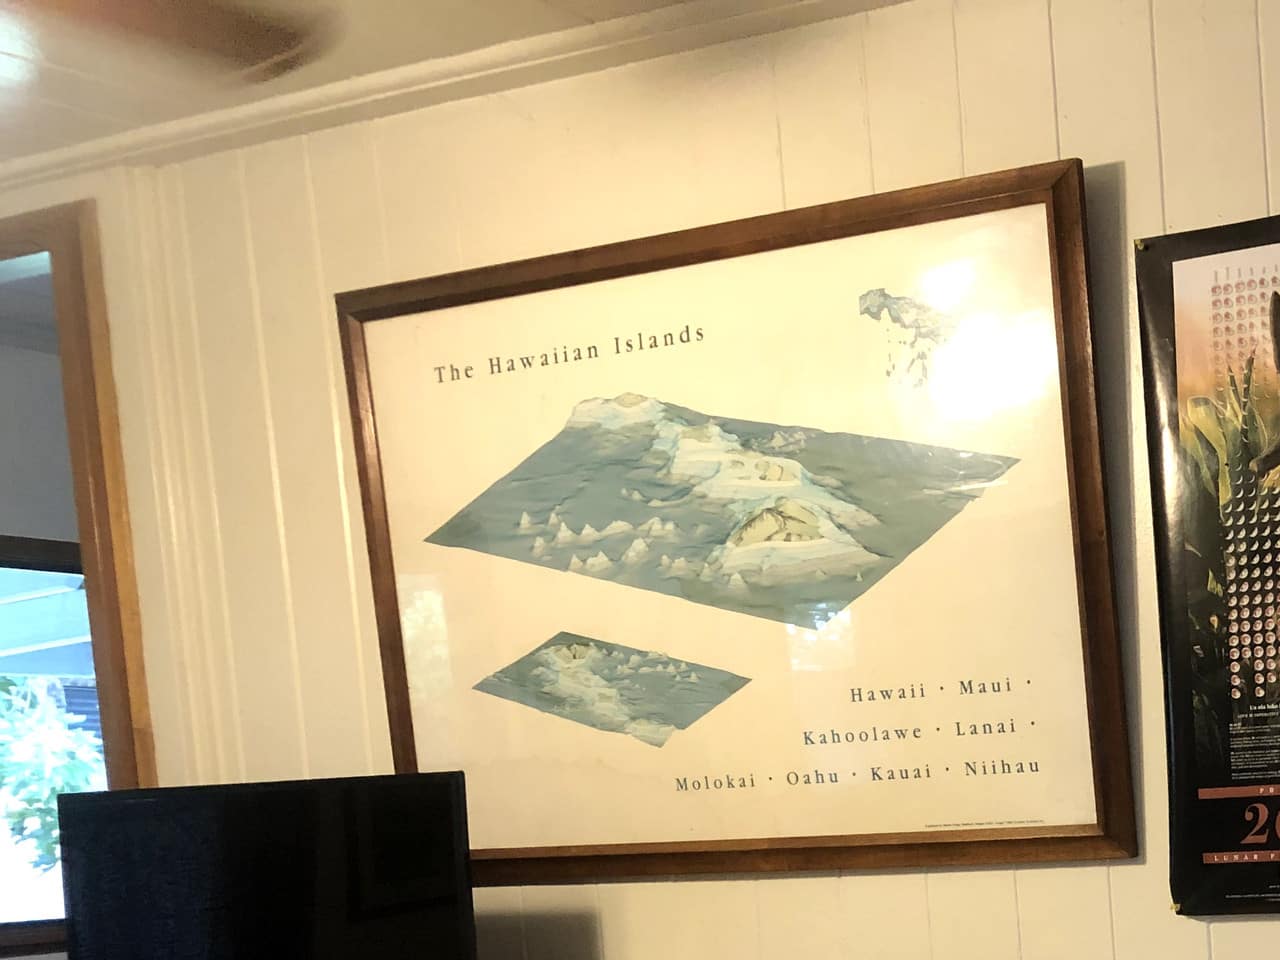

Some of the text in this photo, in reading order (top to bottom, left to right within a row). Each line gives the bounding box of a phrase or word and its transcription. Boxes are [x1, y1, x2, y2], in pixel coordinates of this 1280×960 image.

[434, 325, 704, 383] The Hawaiian Islands
[850, 677, 1012, 702] Hawaii Maui
[803, 718, 1016, 746] Kahoolawe Lanai
[675, 759, 1040, 792] Molokai Oahu Kauai Niihau
[1214, 853, 1258, 862] LUNAR
